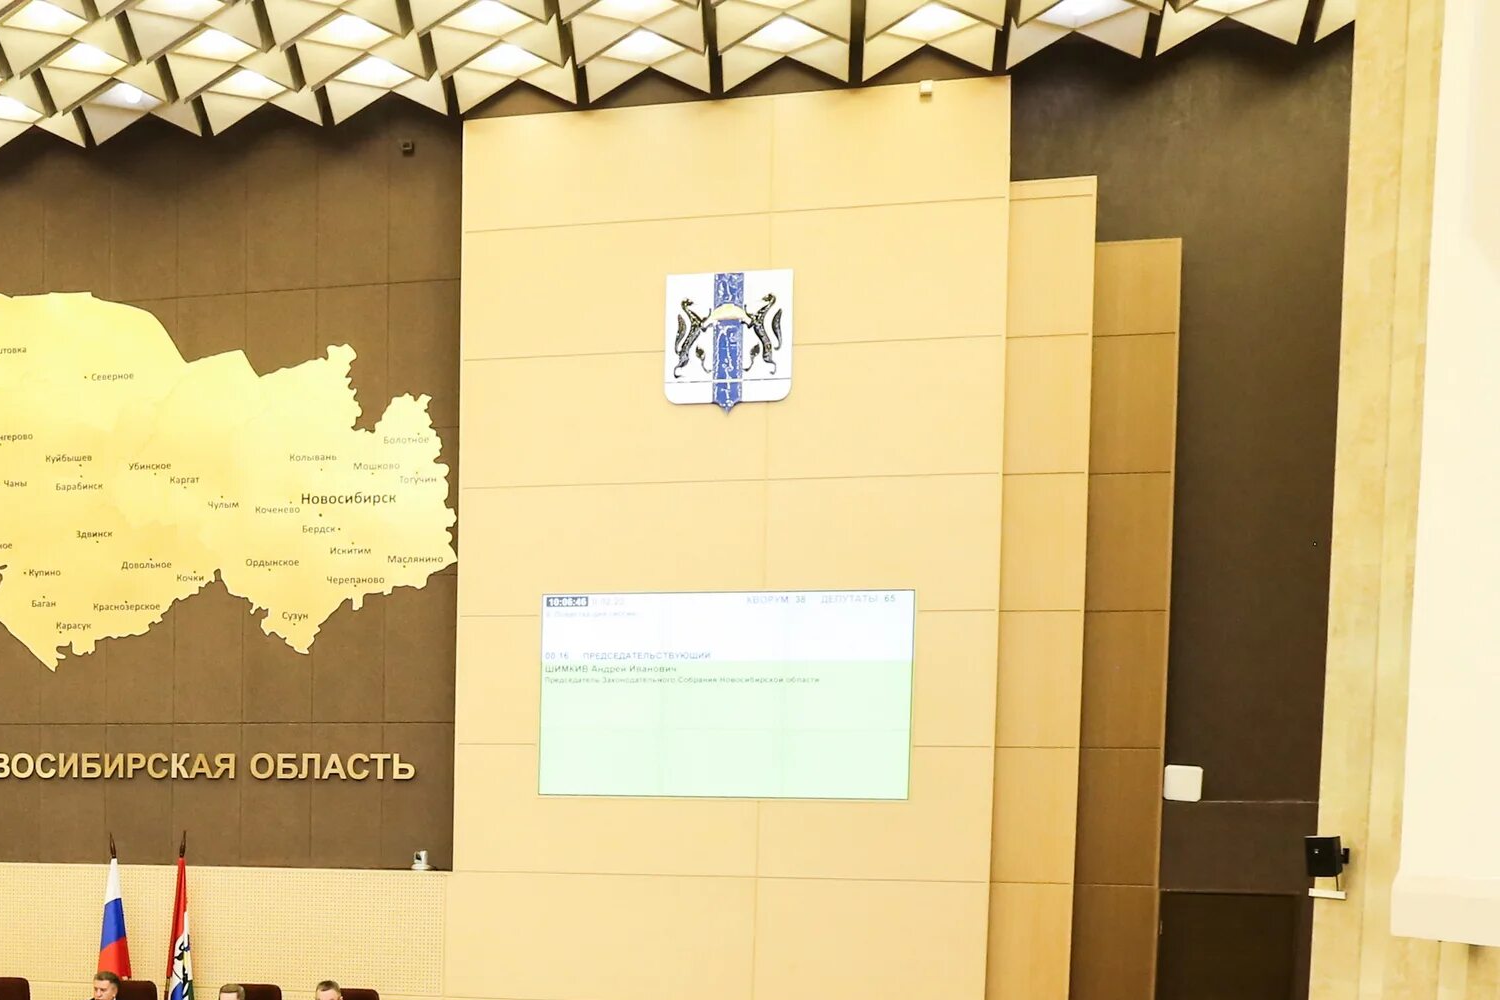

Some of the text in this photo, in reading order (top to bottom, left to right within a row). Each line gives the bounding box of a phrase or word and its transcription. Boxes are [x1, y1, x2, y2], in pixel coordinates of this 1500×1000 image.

[91, 372, 135, 382] Северное
[383, 435, 430, 444] Болотное
[45, 454, 92, 464] Куйбышев
[289, 453, 337, 462] Колывань
[128, 461, 171, 471] Убинское
[353, 461, 400, 470] Мошково
[3, 479, 27, 488] Чаны
[169, 476, 199, 485] Каргат
[399, 475, 437, 485] Тогучин
[55, 482, 103, 491] Барабинск
[300, 491, 397, 506] Новосибирск
[207, 500, 239, 509] Чулым
[254, 505, 300, 514] Коченево
[301, 524, 336, 534] Бердск
[75, 530, 113, 539] Здвинск
[329, 546, 371, 555] Искитим
[245, 558, 300, 568] Ордынское
[387, 554, 444, 564] Маслянино
[28, 569, 61, 578] Купино
[176, 574, 205, 583] Кочки
[326, 575, 385, 585] Черепаново
[31, 600, 56, 608] Баган
[746, 596, 789, 605] КВОРУМ
[820, 594, 896, 605] ДЕПУТАТЫ 65
[93, 602, 161, 612] Краснозерское
[281, 611, 308, 621] Сузун
[56, 621, 92, 631] Карасук
[545, 665, 588, 673] ШИМКИВ
[629, 664, 677, 673] Иванович
[544, 676, 600, 685] Председатель
[602, 676, 675, 685] Законодательного
[677, 675, 717, 685] Собрания
[785, 675, 820, 684] области
[249, 752, 416, 780] ОБЛАСТЬ
